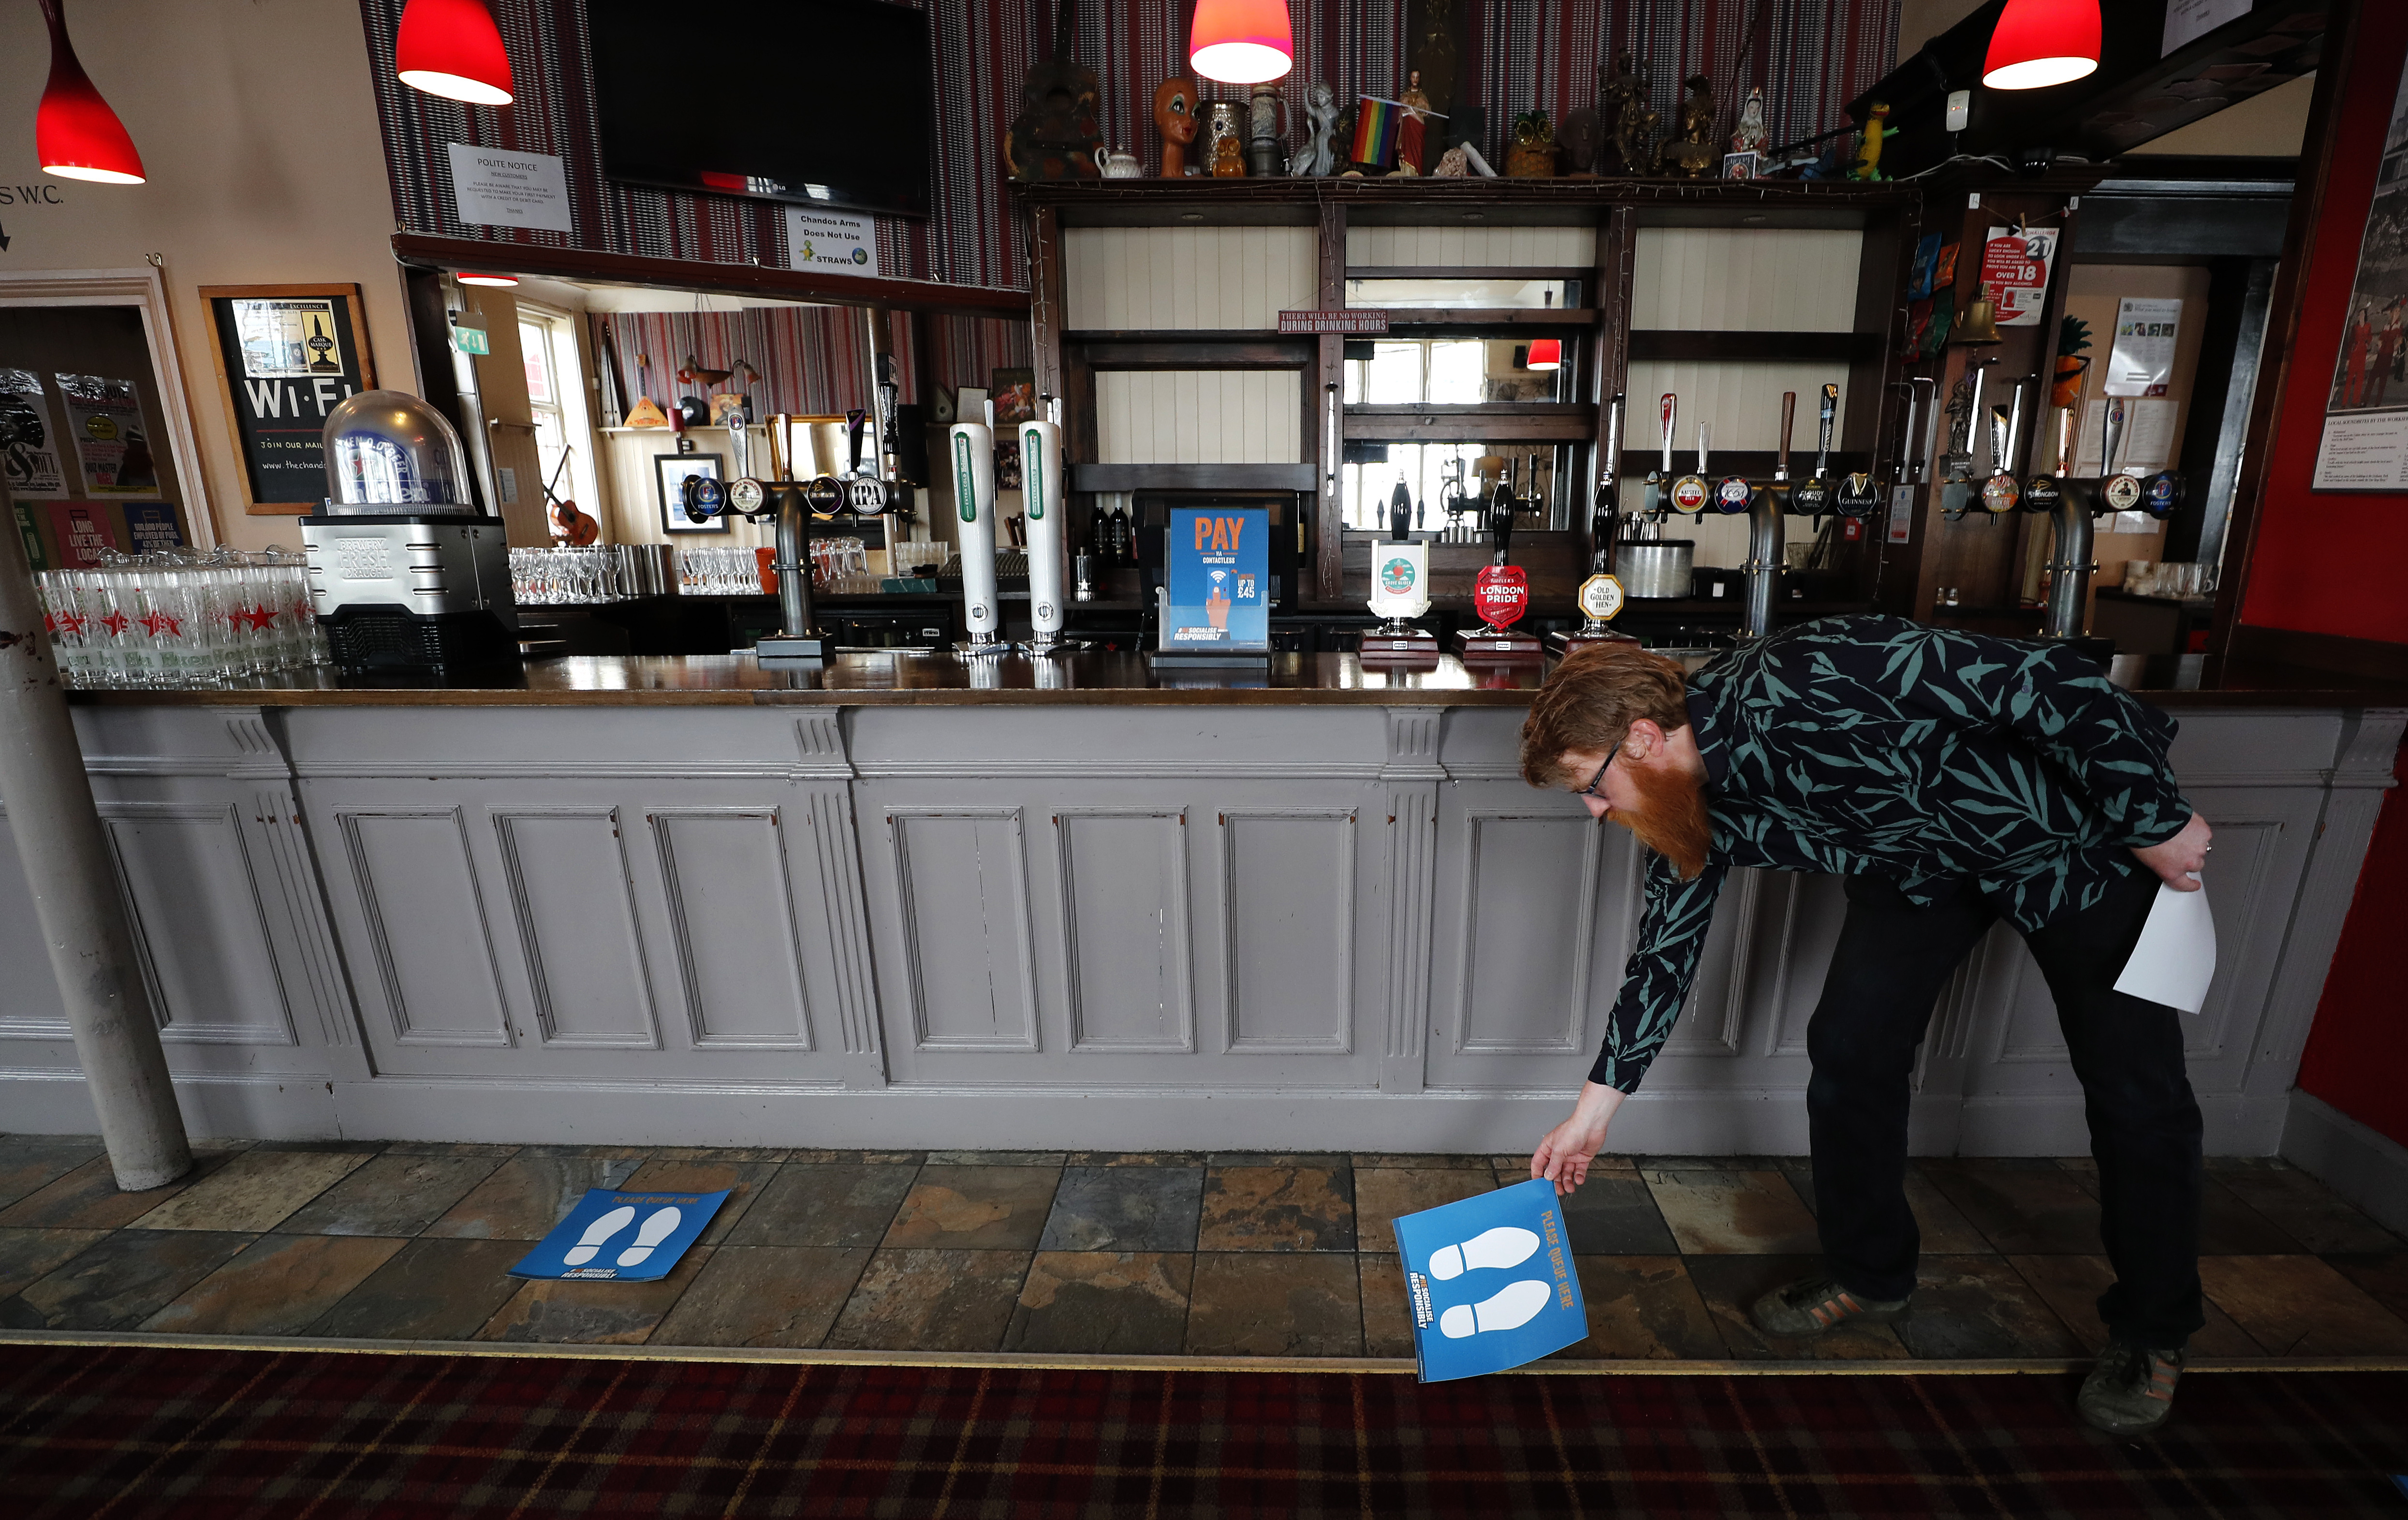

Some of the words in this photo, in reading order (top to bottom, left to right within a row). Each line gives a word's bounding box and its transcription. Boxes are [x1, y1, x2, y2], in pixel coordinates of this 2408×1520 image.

[477, 158, 505, 168] POLITE
[508, 162, 537, 171] NOTICE
[16, 185, 63, 204] W.C.
[801, 215, 837, 225] Chandos
[839, 219, 861, 228] Arms
[804, 229, 824, 237] Does
[2026, 239, 2050, 256] 21
[817, 256, 852, 265] STRAWS
[2017, 265, 2037, 280] 18
[1281, 320, 1313, 331] DURING
[1315, 320, 1356, 331] DRINKING
[1359, 319, 1386, 330] HOURS
[260, 438, 282, 449] JOIN
[854, 485, 882, 505] IPA
[1725, 488, 1745, 498] 1664
[2027, 490, 2058, 499] STRONGBOW
[71, 520, 94, 533] LONG
[134, 531, 158, 540] EMPLOYED
[1195, 517, 1245, 550] PAY
[68, 534, 87, 547] LIVE
[88, 534, 104, 546] THE
[339, 540, 384, 550] BREWERY
[340, 550, 388, 567] FRESH
[345, 568, 388, 577] DRAUGHT
[1237, 588, 1255, 598] £45
[1480, 586, 1524, 595] LONDON
[1486, 594, 1518, 603] PRIDE
[1541, 1210, 1558, 1247] PLEASE
[1547, 1247, 1567, 1282] QUEUE
[1410, 1272, 1427, 1329] RESPONSIBLY
[1419, 1274, 1434, 1322] #RESOCIALISE
[1556, 1280, 1574, 1311] HERE
